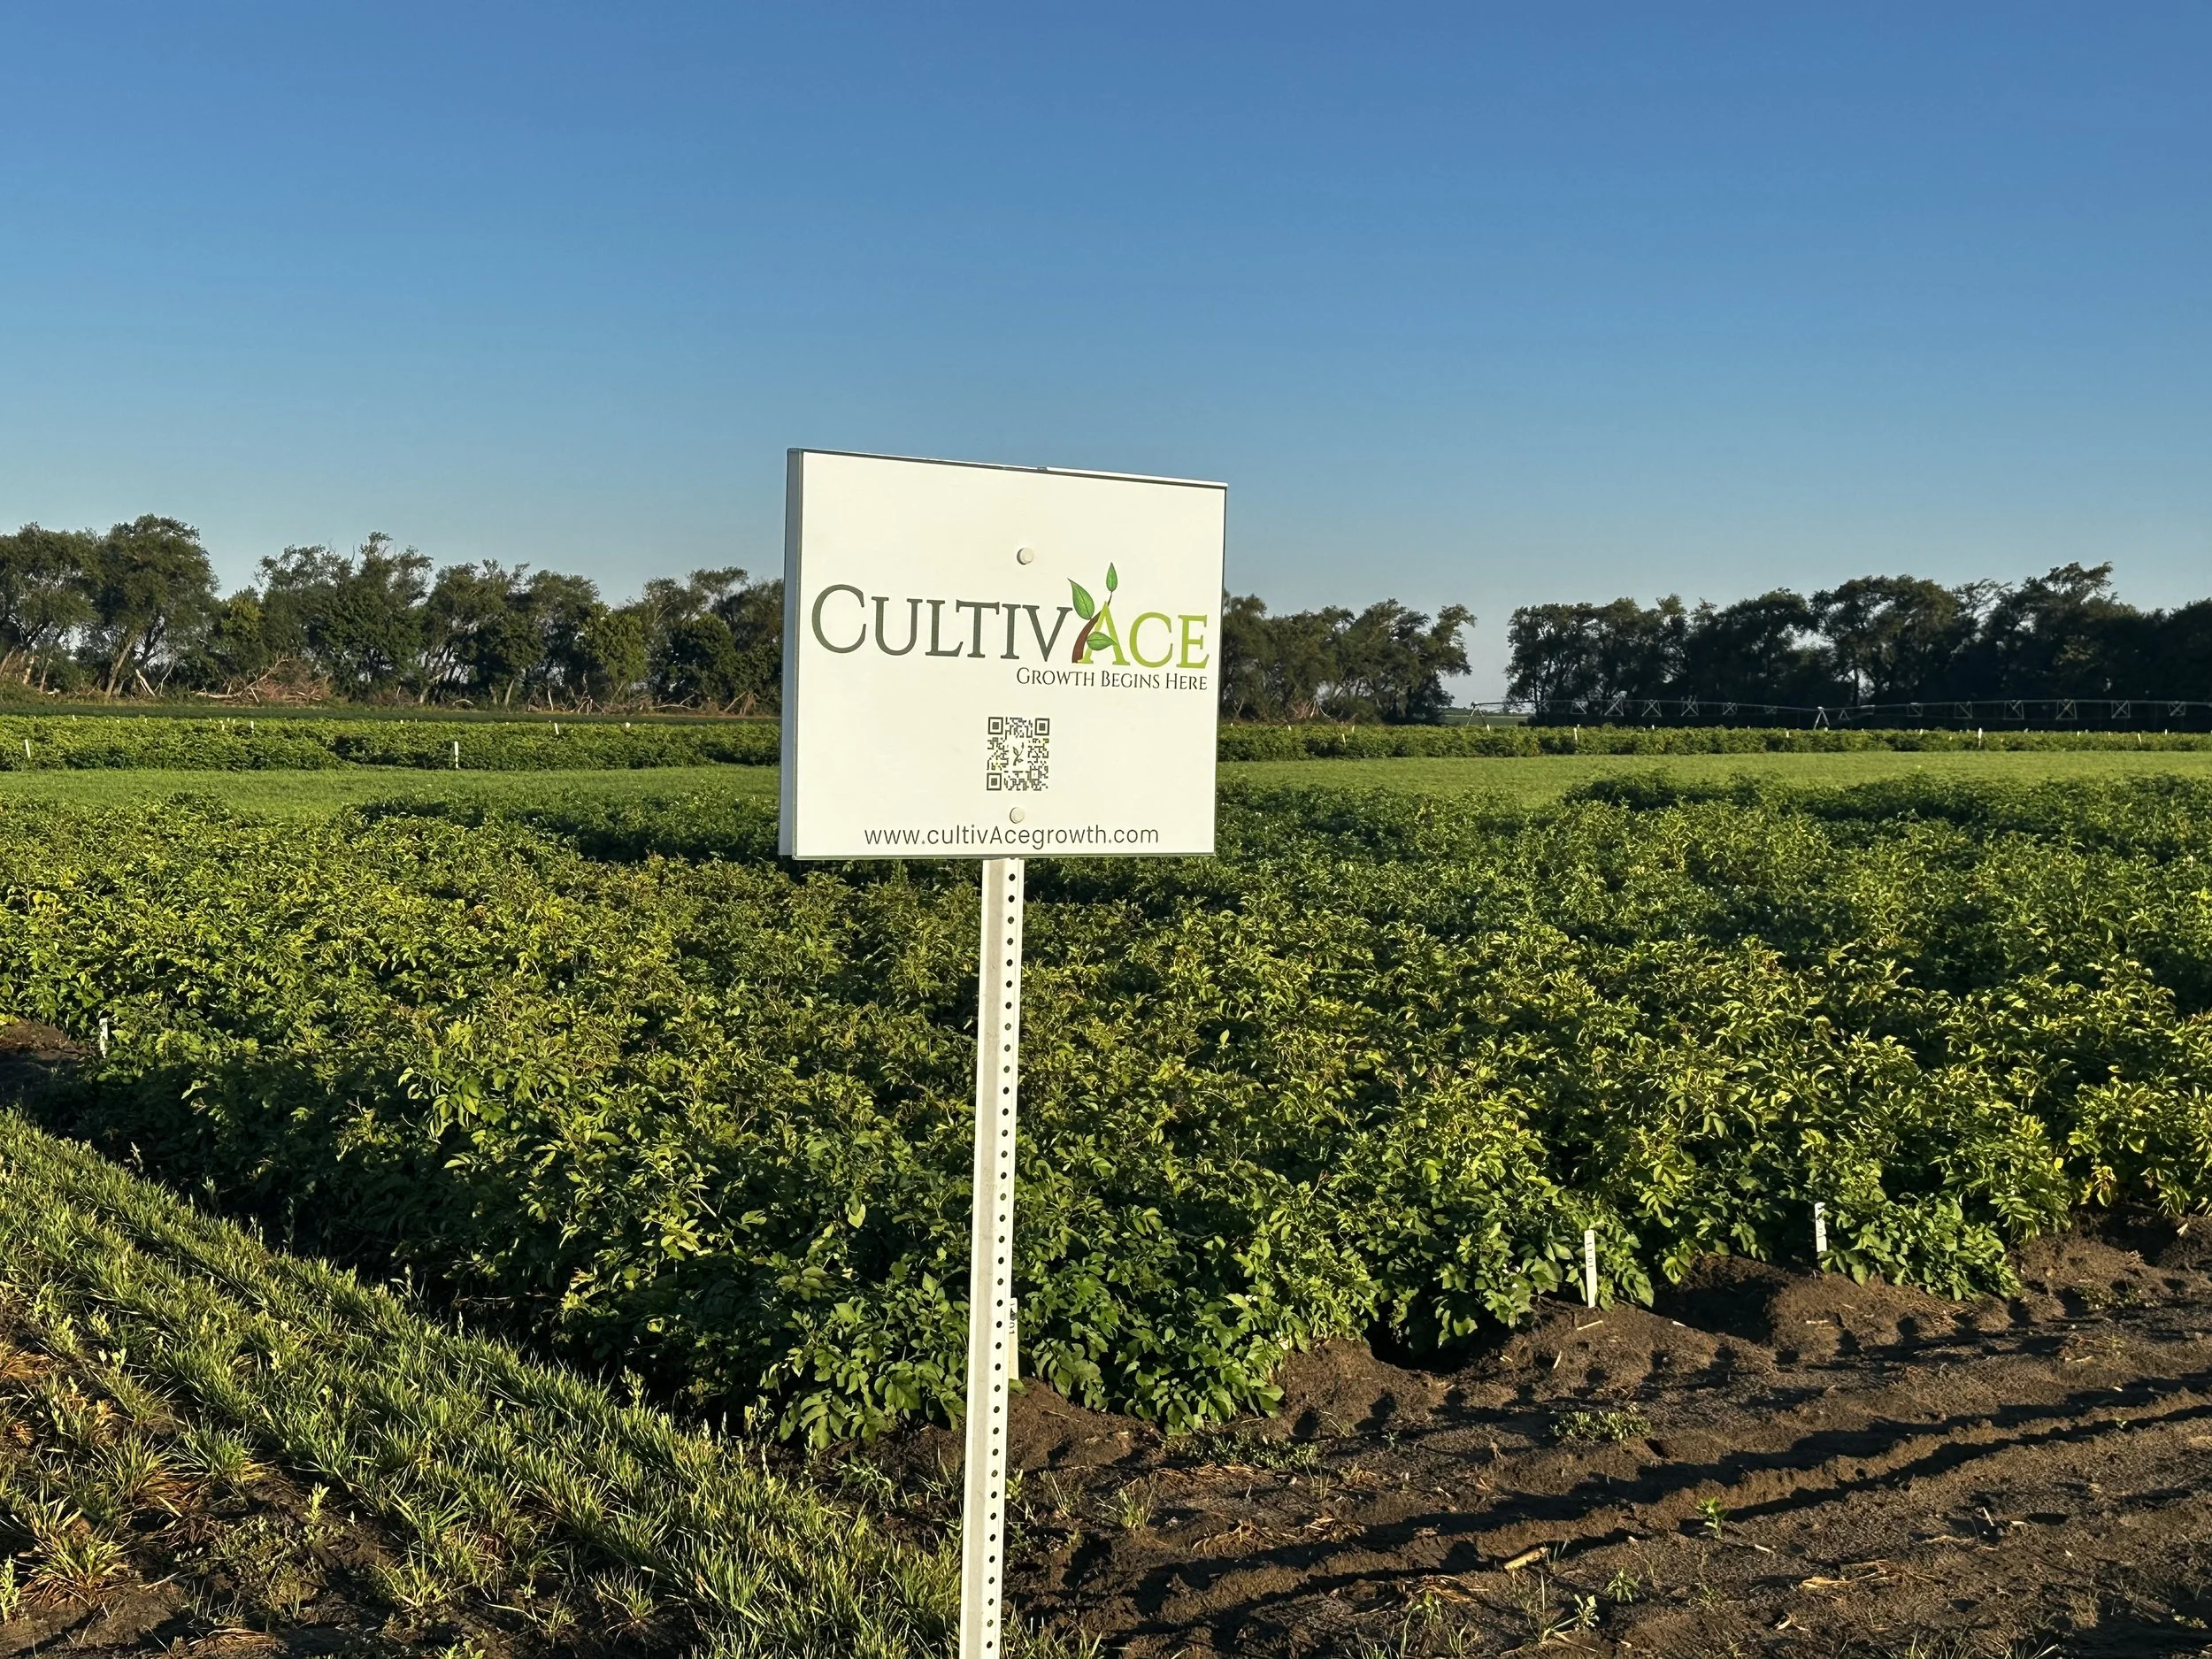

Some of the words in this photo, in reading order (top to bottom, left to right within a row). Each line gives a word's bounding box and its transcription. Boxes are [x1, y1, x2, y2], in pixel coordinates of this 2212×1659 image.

[1017, 666, 1095, 687] GROWTH
[1101, 670, 1160, 689] BEGINS
[1165, 672, 1208, 690] HERE
[864, 824, 1159, 850] www.cultivAcegrowth.com
